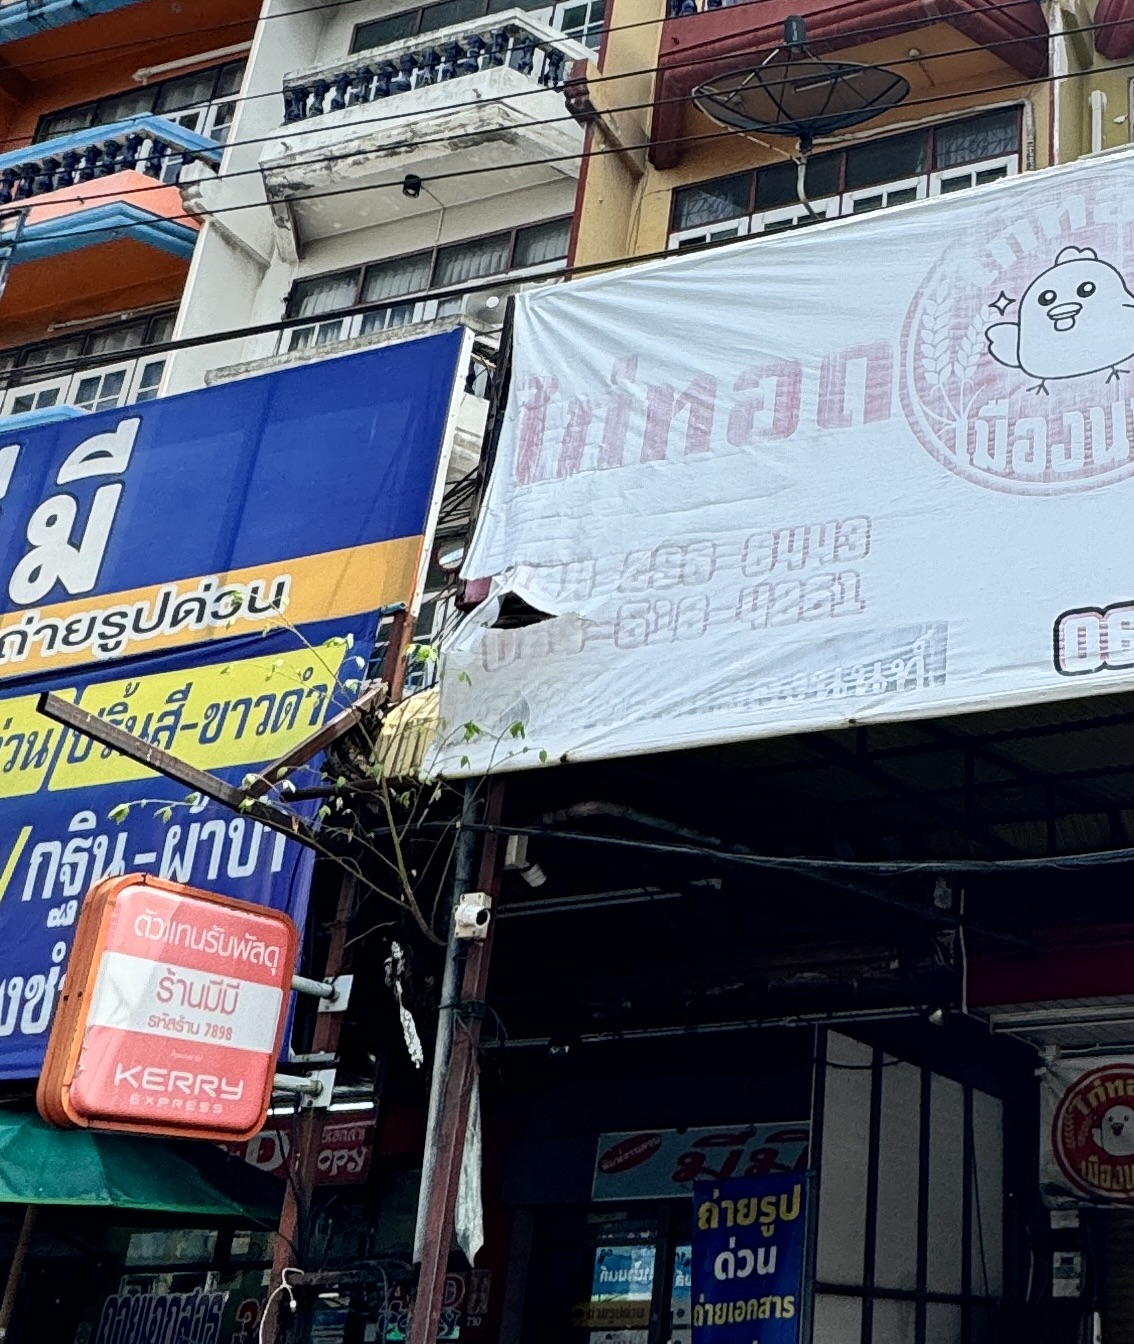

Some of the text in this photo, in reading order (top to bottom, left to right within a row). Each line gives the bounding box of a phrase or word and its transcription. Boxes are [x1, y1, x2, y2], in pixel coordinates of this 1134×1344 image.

[133, 908, 280, 976] ตัวแทนรับพัสดุ
[156, 968, 241, 1016] ร้านมีมี
[147, 1014, 234, 1041] รหัสร้าน 7898
[113, 1063, 244, 1101] KERRY
[128, 1093, 223, 1114] EXPRESS
[316, 1145, 368, 1177] opy
[697, 1184, 801, 1238] ถ่ายรูป
[713, 1236, 778, 1282] ด่วน
